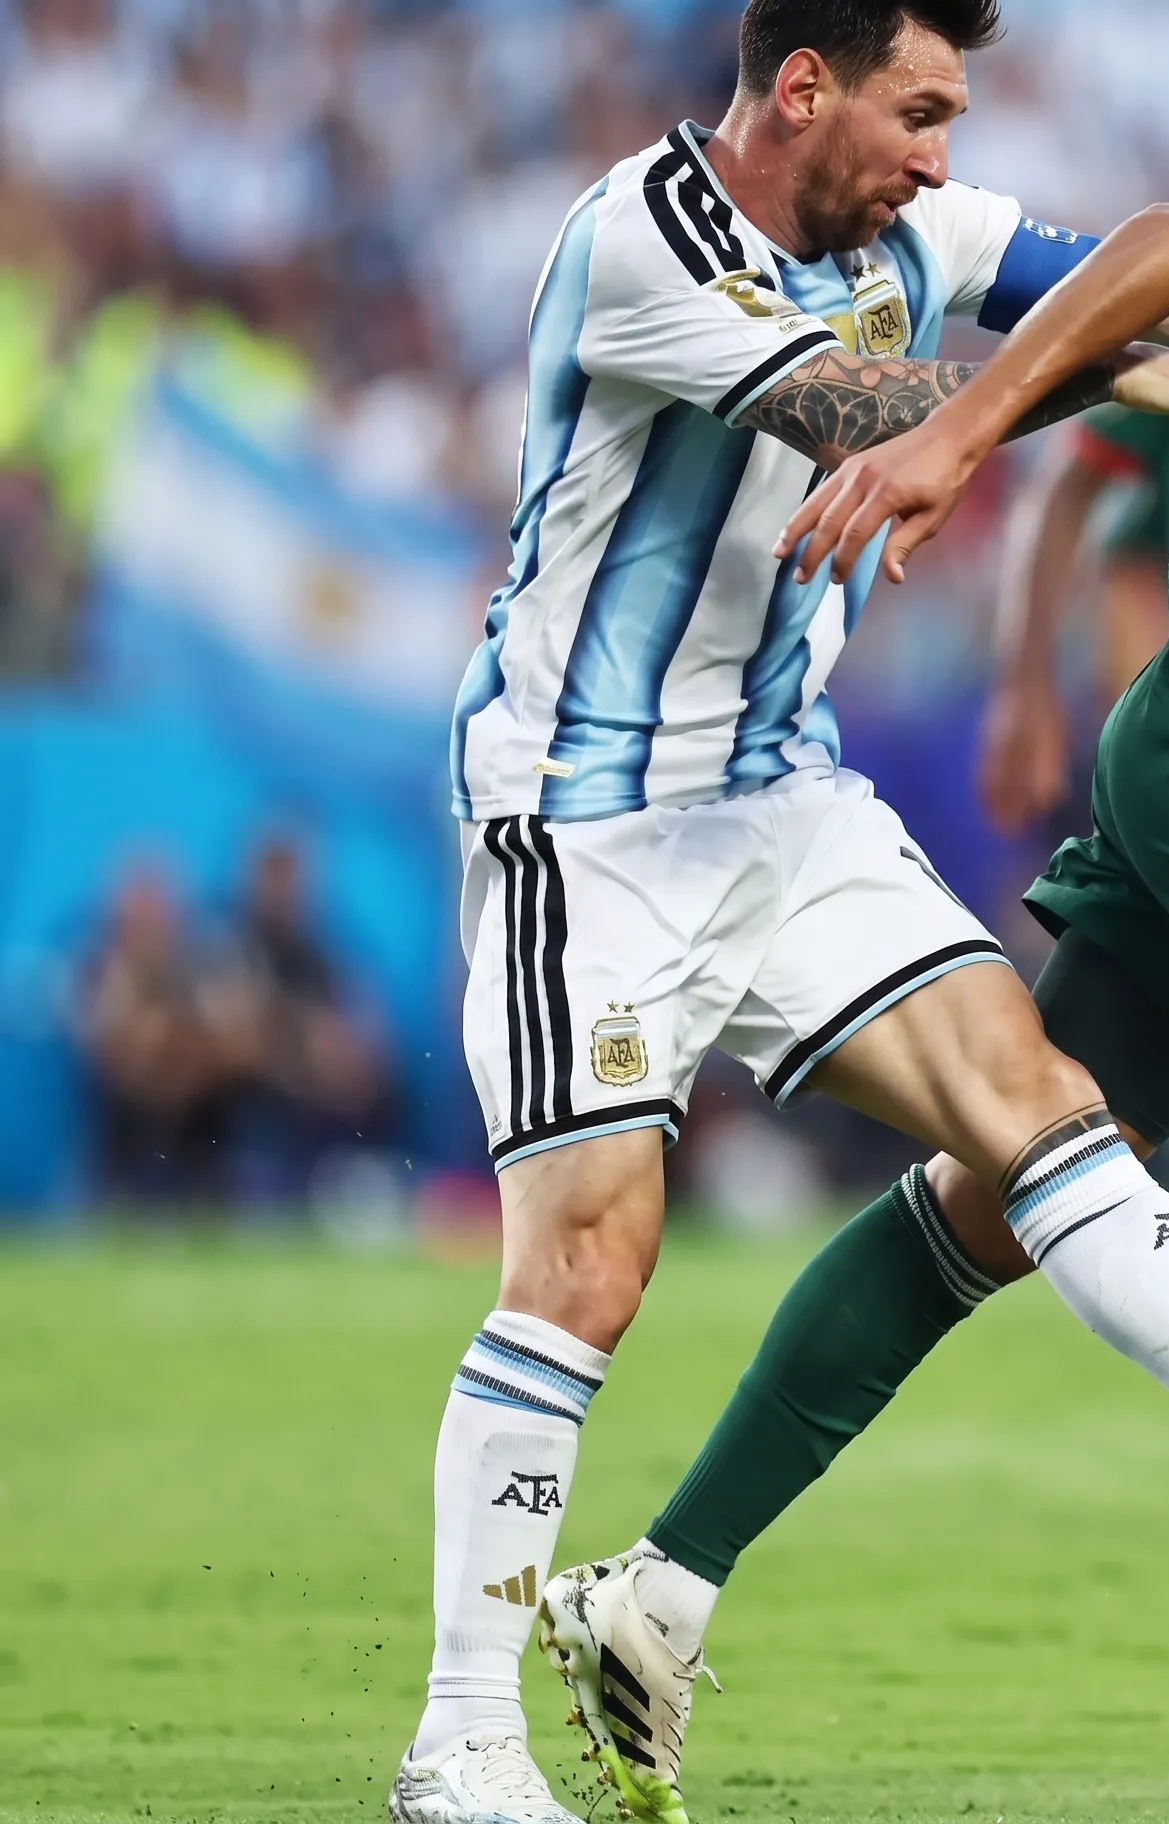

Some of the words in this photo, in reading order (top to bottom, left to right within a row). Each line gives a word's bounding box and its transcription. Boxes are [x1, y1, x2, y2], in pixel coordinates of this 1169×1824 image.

[868, 304, 898, 341] AFA
[607, 1037, 636, 1068] AFA
[491, 1470, 563, 1516] AFA
